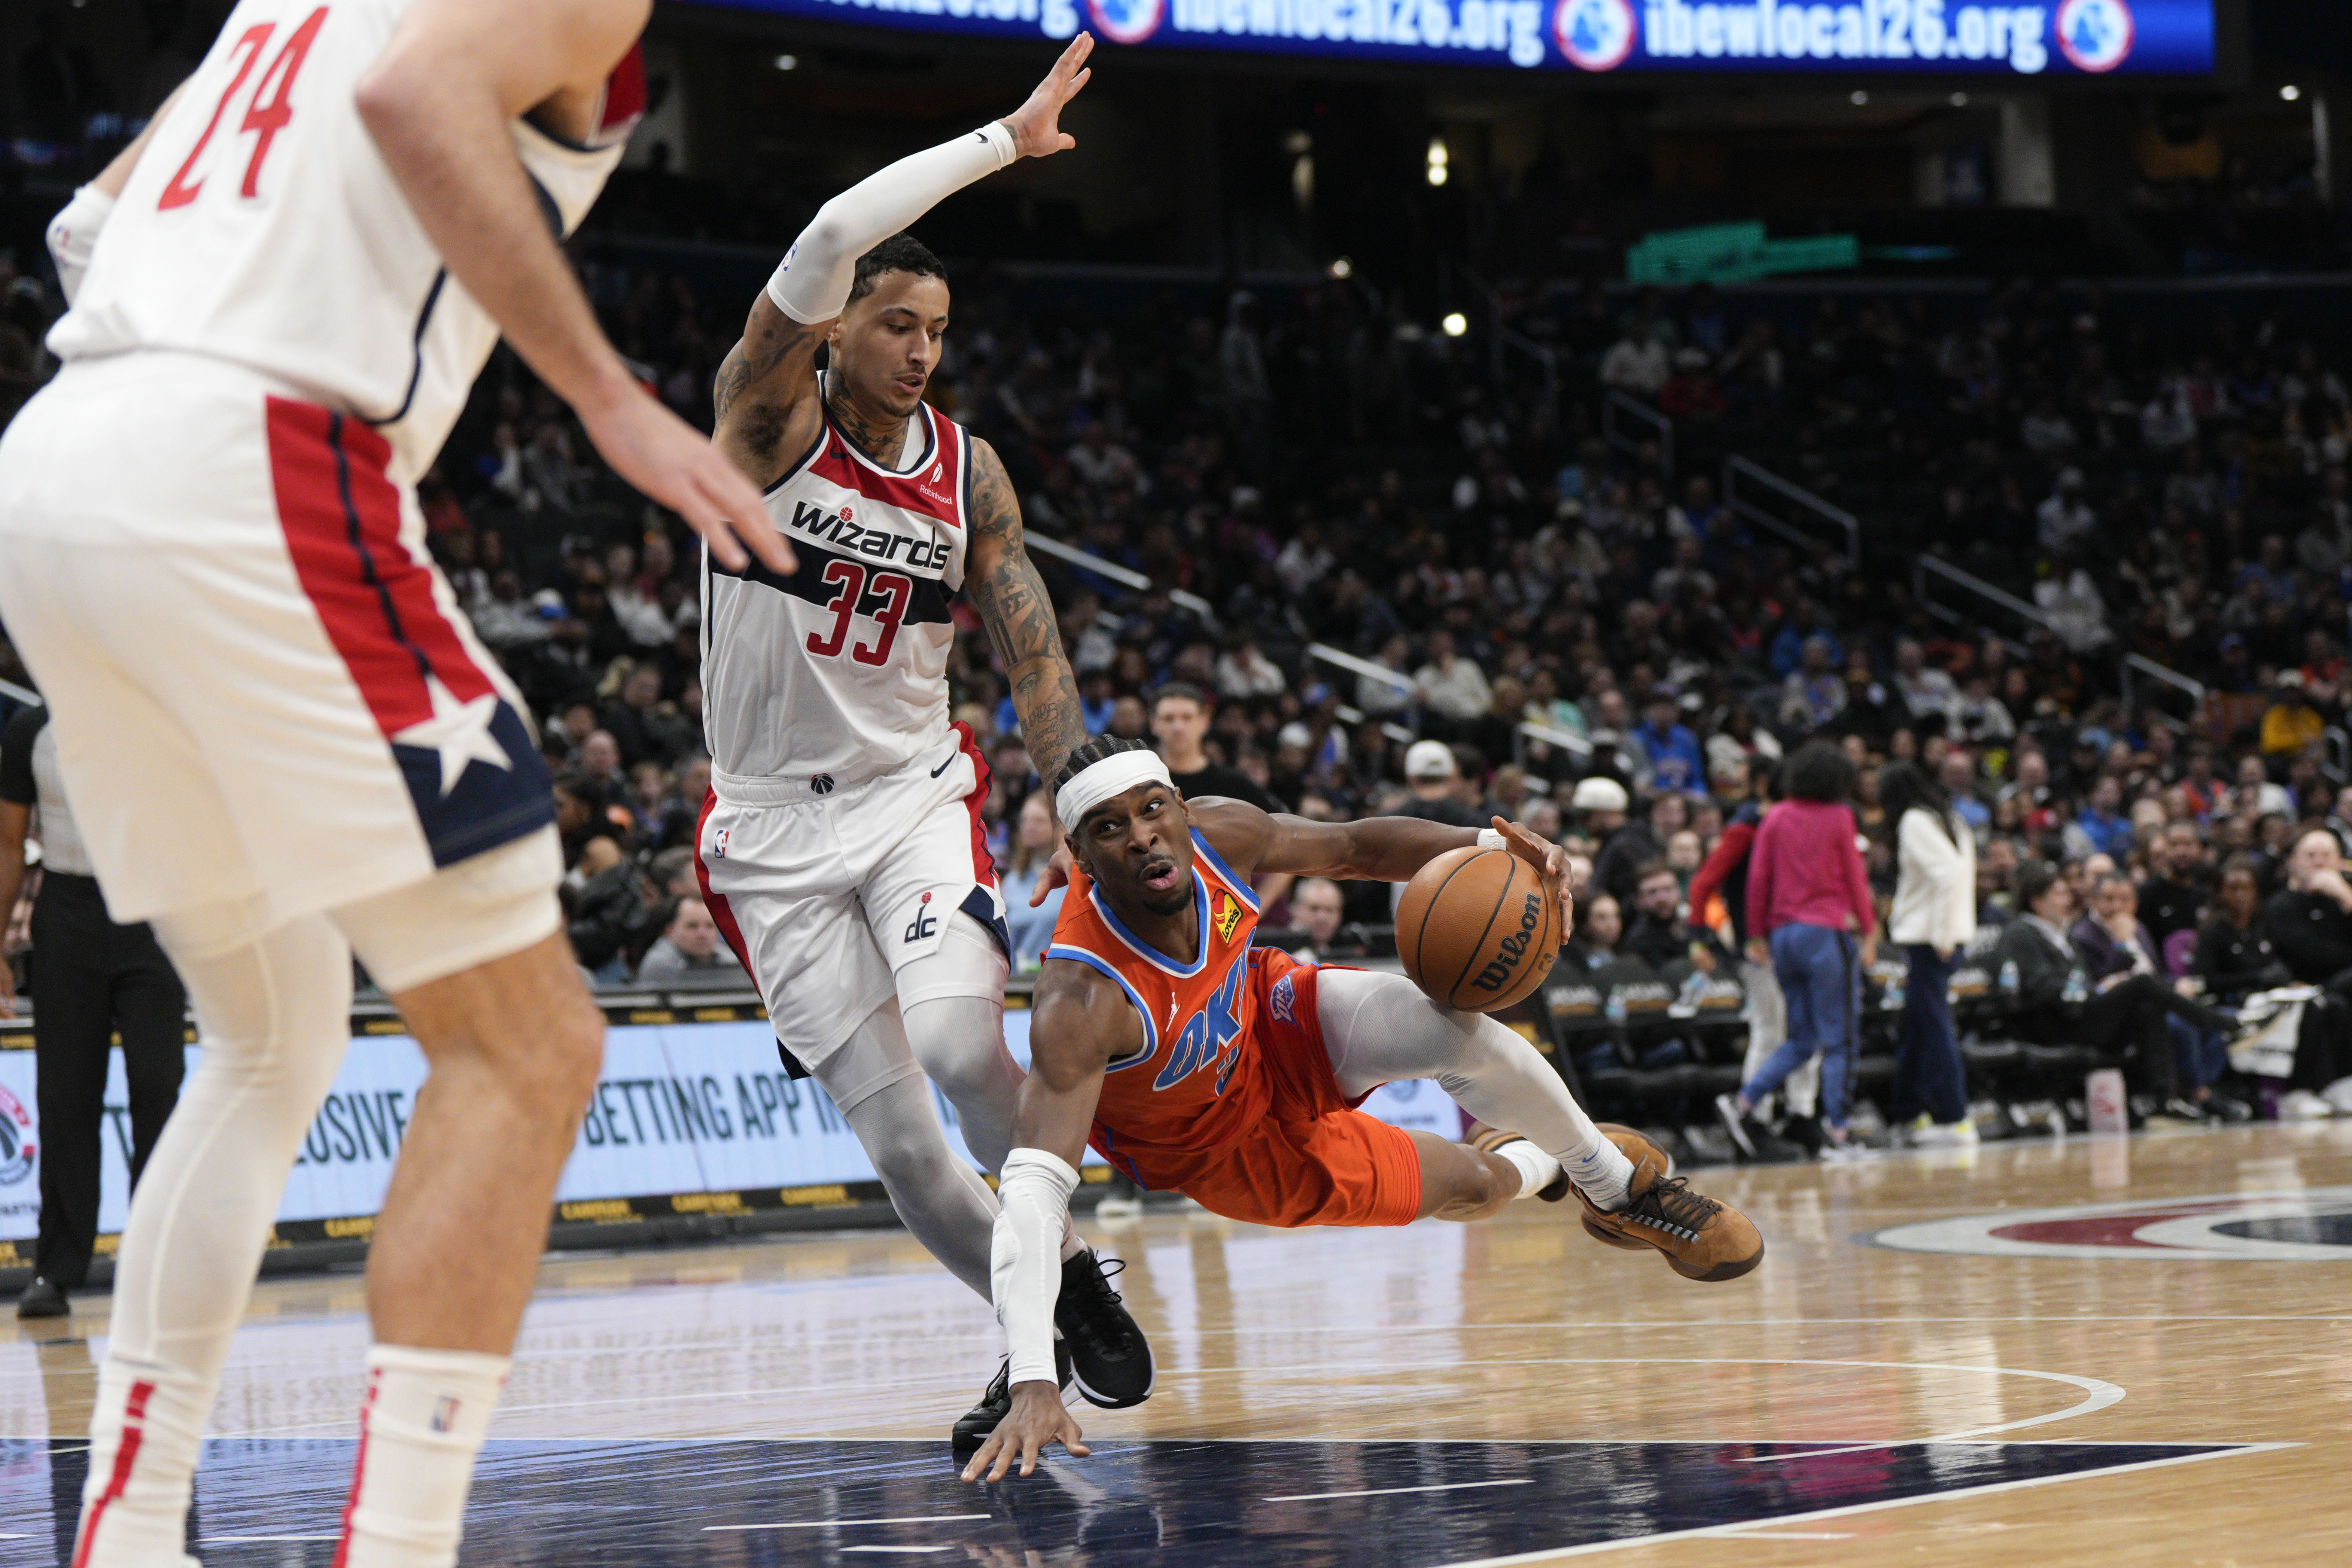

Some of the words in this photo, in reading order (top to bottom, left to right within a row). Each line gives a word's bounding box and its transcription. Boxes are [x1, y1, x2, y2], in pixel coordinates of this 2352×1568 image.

[1644, 0, 2048, 74] ibewlocal26.org
[156, 6, 329, 213] 24
[920, 484, 952, 505] Robinhood
[803, 559, 913, 670] 33
[904, 904, 937, 943] dc
[1470, 892, 1541, 992] Wilson
[735, 1072, 801, 1138] APP
